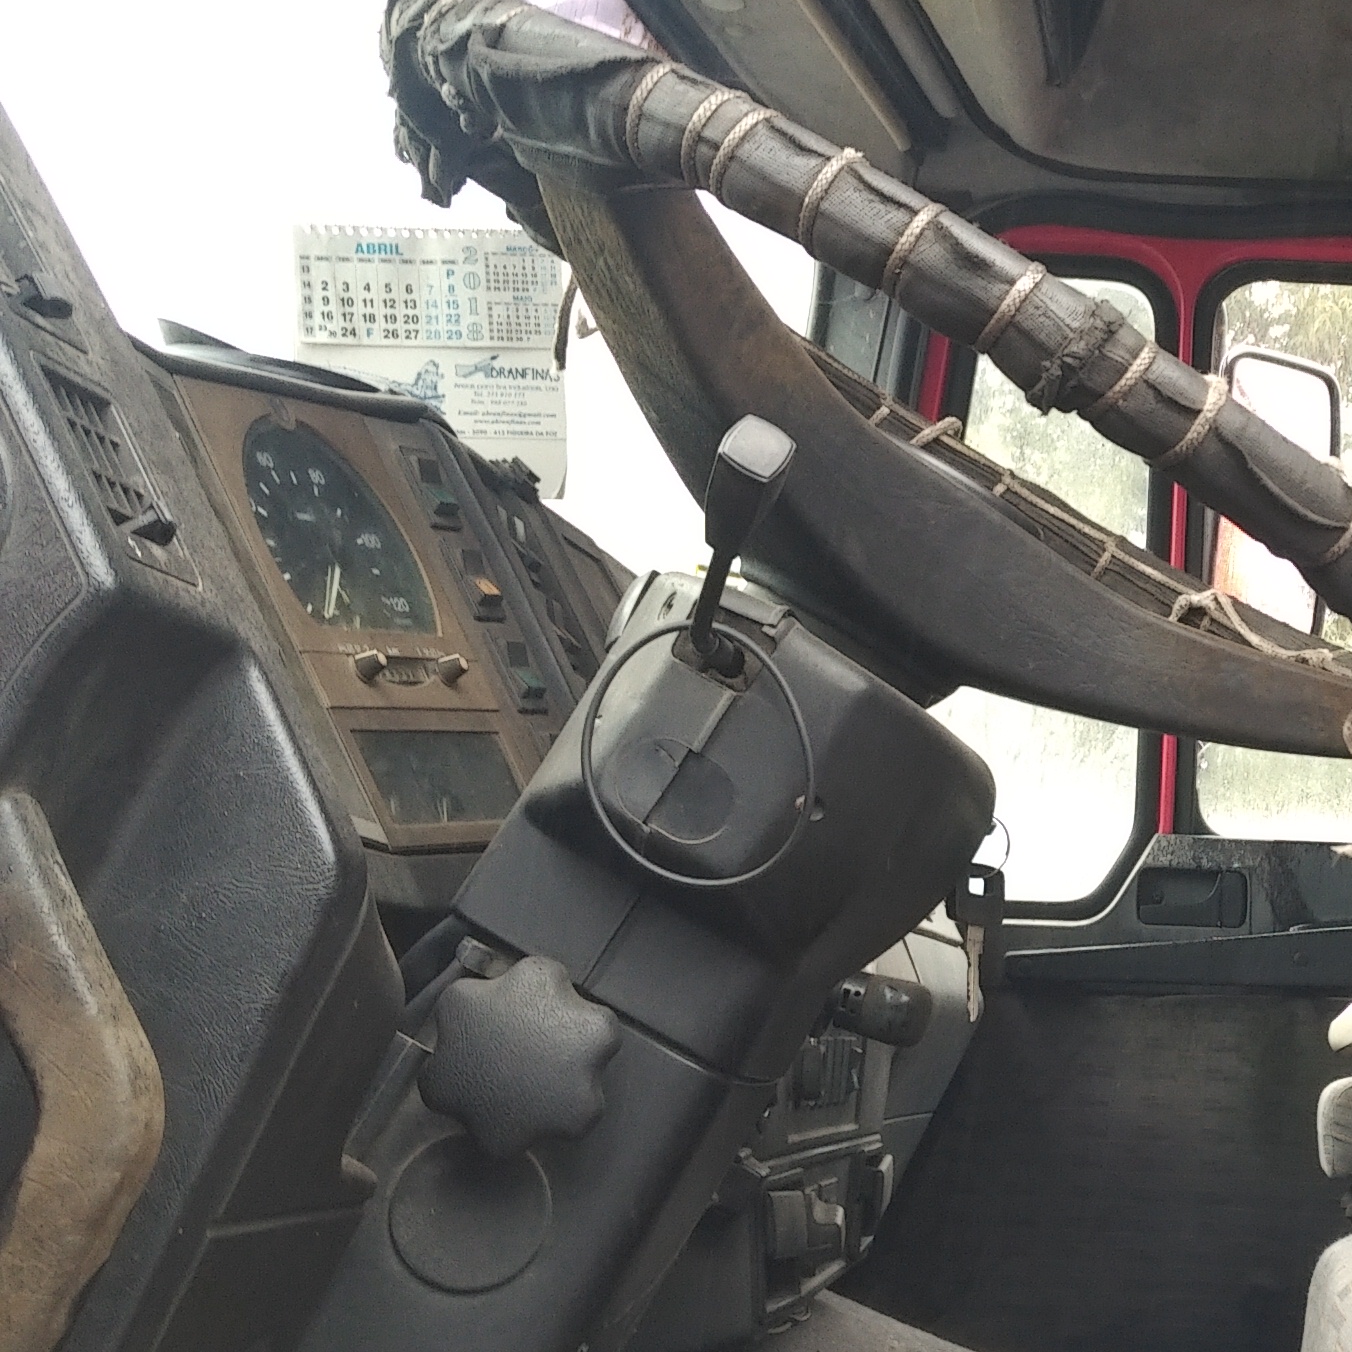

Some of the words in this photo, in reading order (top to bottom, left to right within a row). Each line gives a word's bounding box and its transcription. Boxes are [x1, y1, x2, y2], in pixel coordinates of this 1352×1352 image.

[355, 243, 404, 256] ABRIL
[446, 269, 455, 280] P
[302, 281, 311, 289] 14
[321, 280, 329, 292] 2
[342, 281, 350, 293] 3
[363, 282, 371, 294] 4
[384, 283, 392, 294] 5
[405, 283, 413, 295] 6
[427, 284, 434, 295] 7
[303, 296, 312, 305] 15
[322, 296, 330, 307] 9
[340, 297, 354, 308] 10
[362, 298, 374, 309] 11
[382, 298, 396, 310] 12
[403, 298, 417, 310] 13
[425, 299, 438, 310] 14
[446, 299, 459, 310] 15
[320, 310, 334, 322] 16
[341, 312, 355, 323] 17
[362, 313, 376, 324] 18
[383, 313, 397, 325] 19
[403, 313, 419, 325] 20
[425, 314, 439, 325] 21
[446, 313, 461, 325] 22
[341, 327, 357, 338] 24
[366, 328, 375, 338] F
[383, 328, 399, 340] 26
[404, 329, 420, 340] 27
[425, 329, 441, 340] 28
[446, 329, 462, 340] 29
[308, 468, 325, 485] 80
[361, 533, 381, 549] 100
[389, 596, 410, 613] 120
